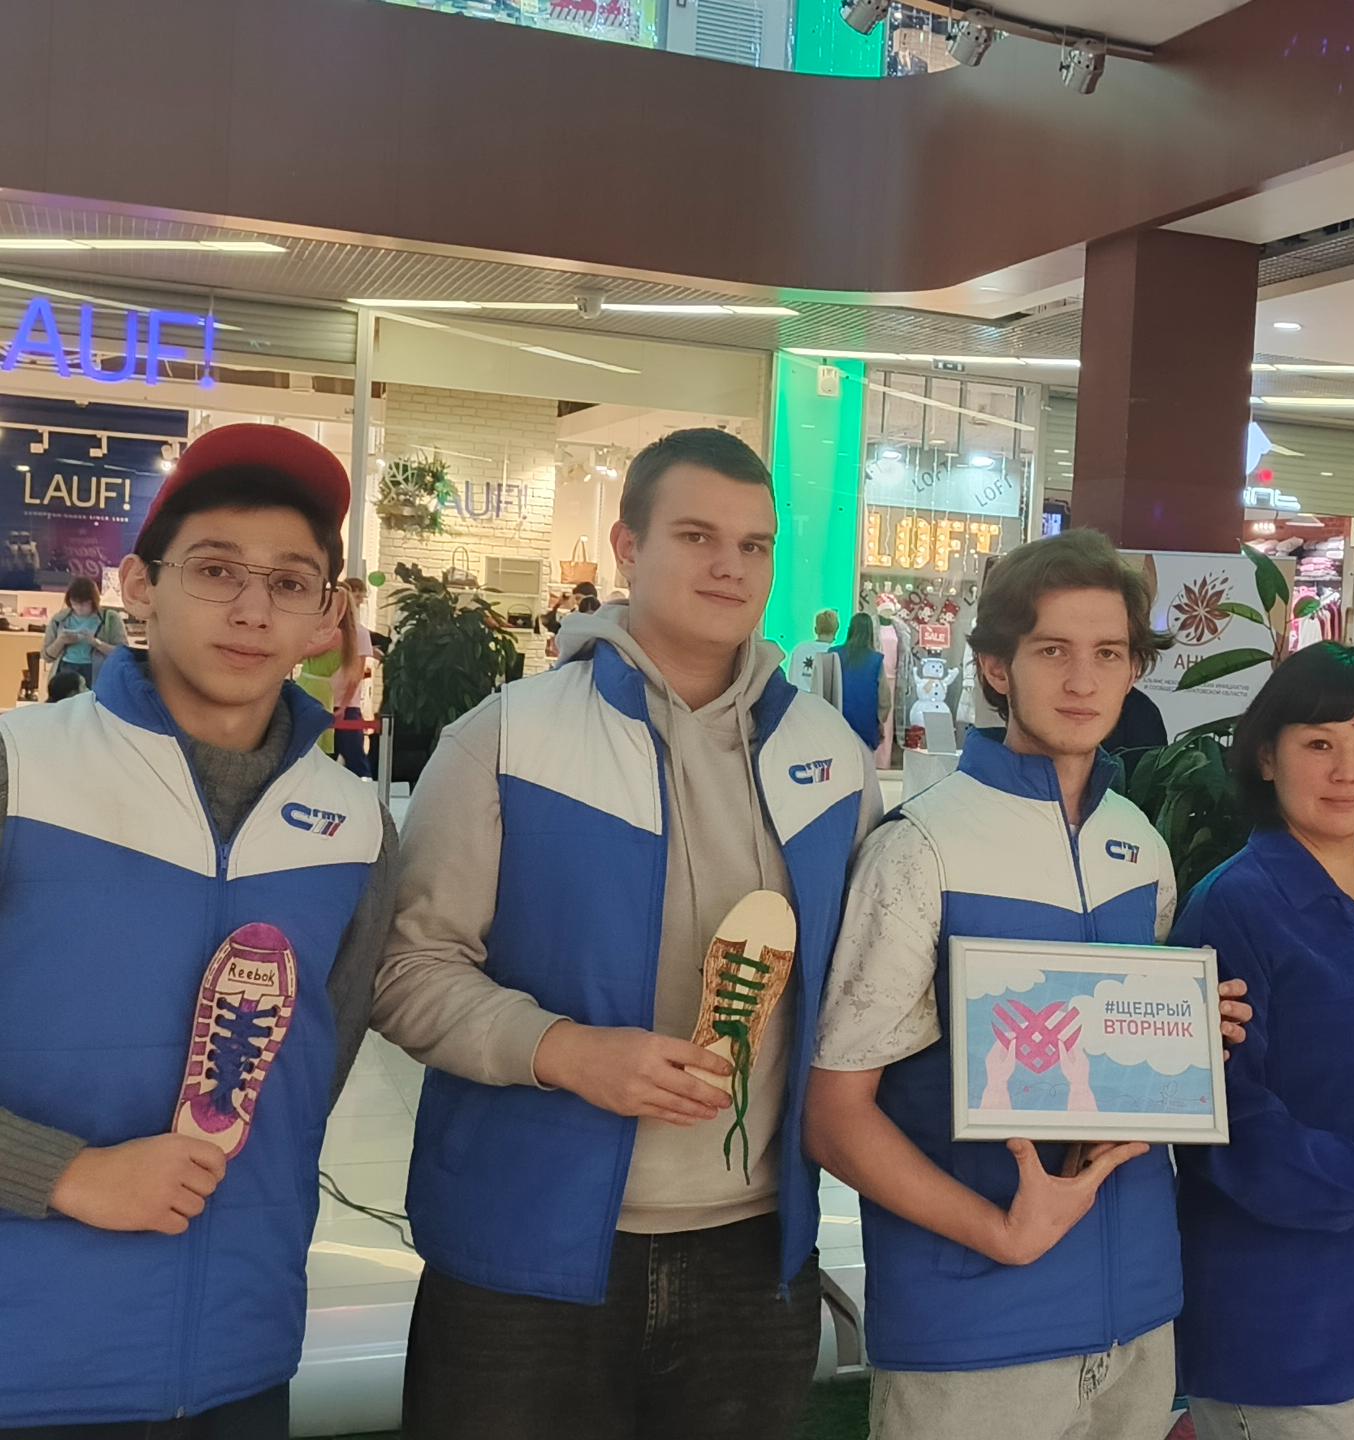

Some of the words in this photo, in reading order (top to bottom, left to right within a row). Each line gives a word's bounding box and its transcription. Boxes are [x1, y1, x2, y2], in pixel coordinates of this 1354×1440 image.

[1, 297, 215, 388] AUF!
[25, 472, 131, 511] LAUF!
[975, 473, 1013, 508] LOFT
[865, 513, 999, 571] LOFT
[924, 630, 946, 643] SALE
[1105, 1000, 1191, 1018] #ЩЕДРЫЙ
[1104, 1019, 1193, 1038] ВТОРНИК
